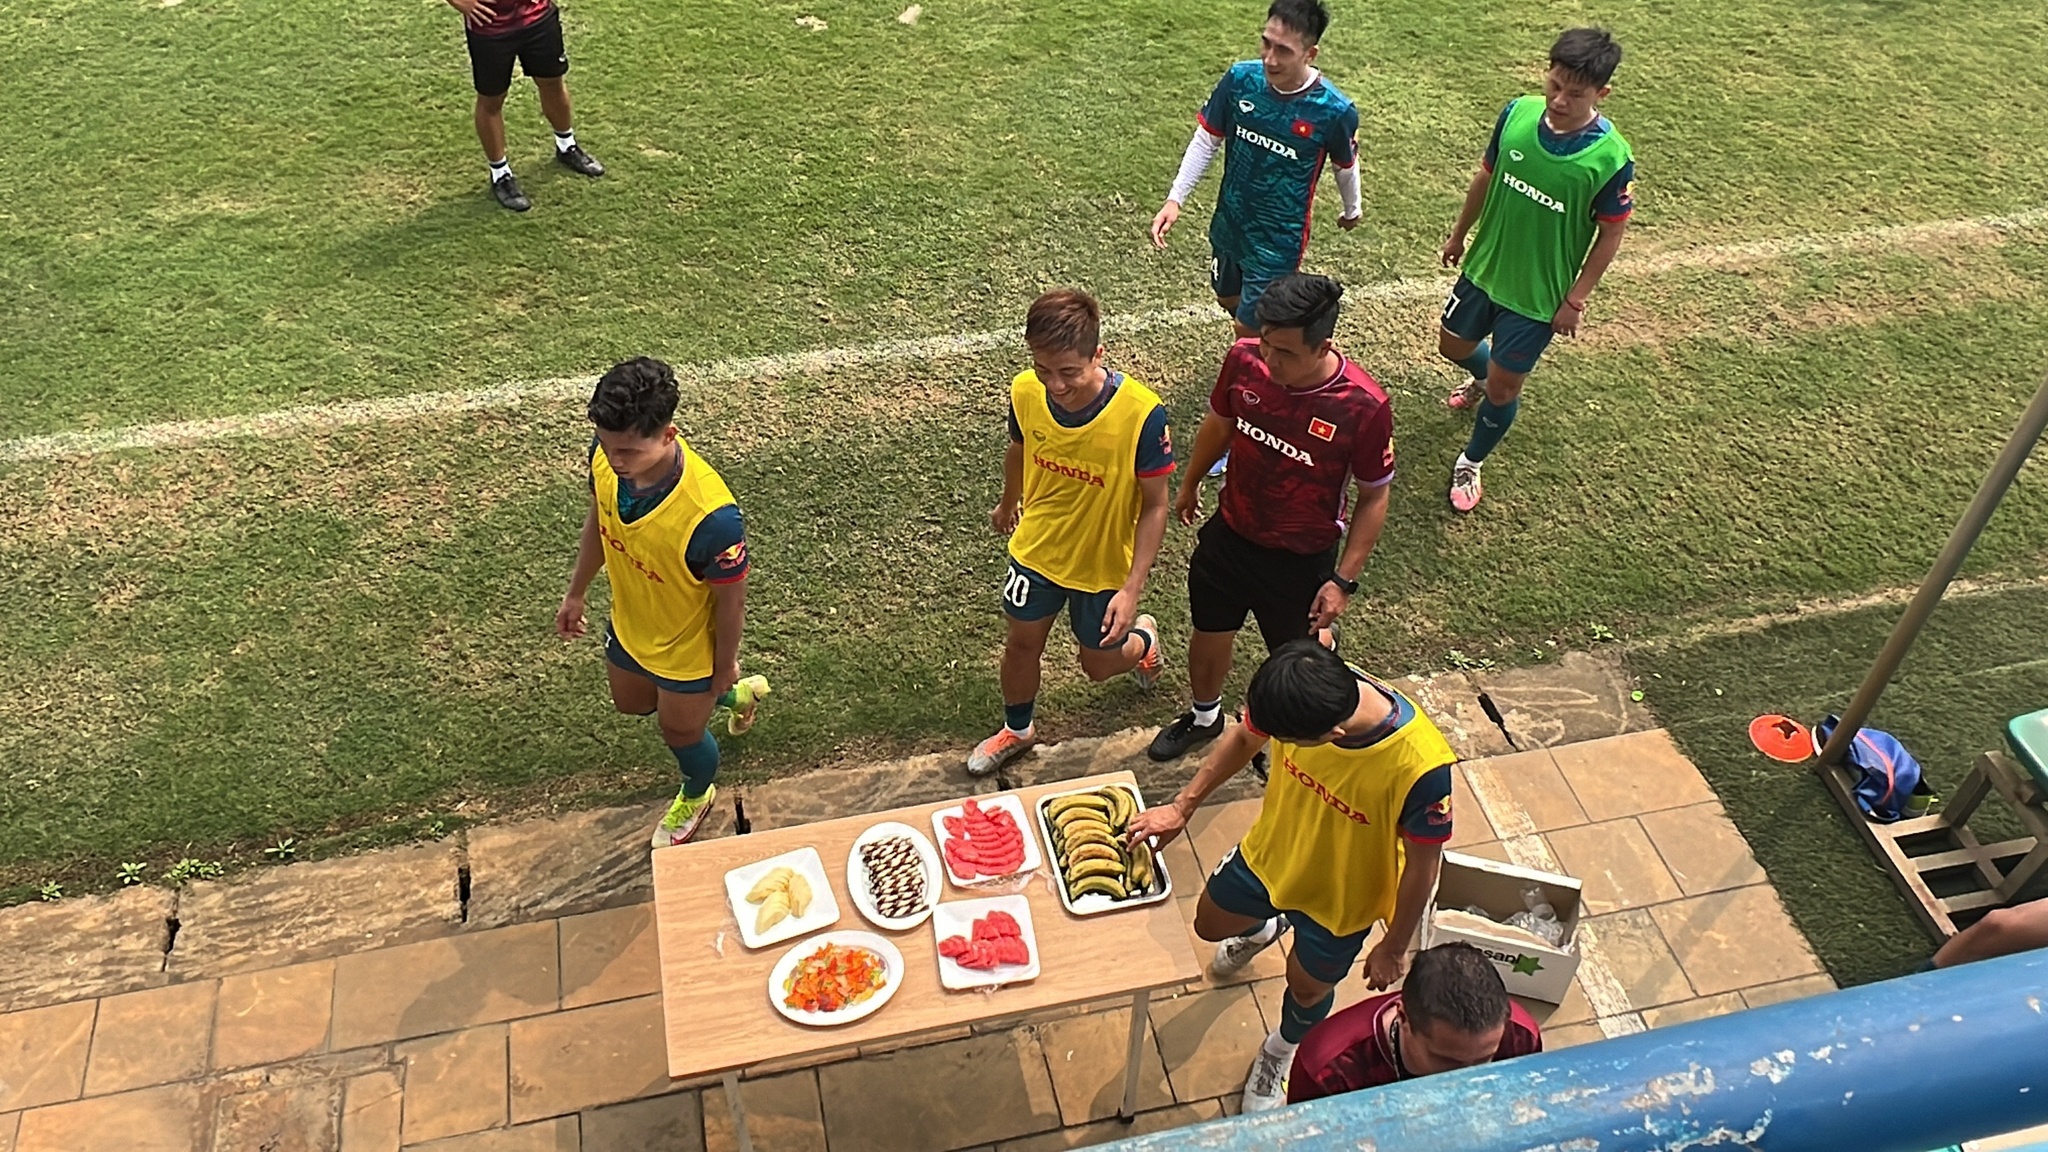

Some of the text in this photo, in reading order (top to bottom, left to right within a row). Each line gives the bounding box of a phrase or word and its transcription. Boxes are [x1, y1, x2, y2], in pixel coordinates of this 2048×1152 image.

[1236, 124, 1299, 160] HONDA
[1503, 172, 1566, 213] HONDA
[1236, 416, 1315, 467] HONDA
[1033, 454, 1106, 490] HONDA
[1004, 565, 1030, 607] 20
[1284, 756, 1371, 826] HONDA
